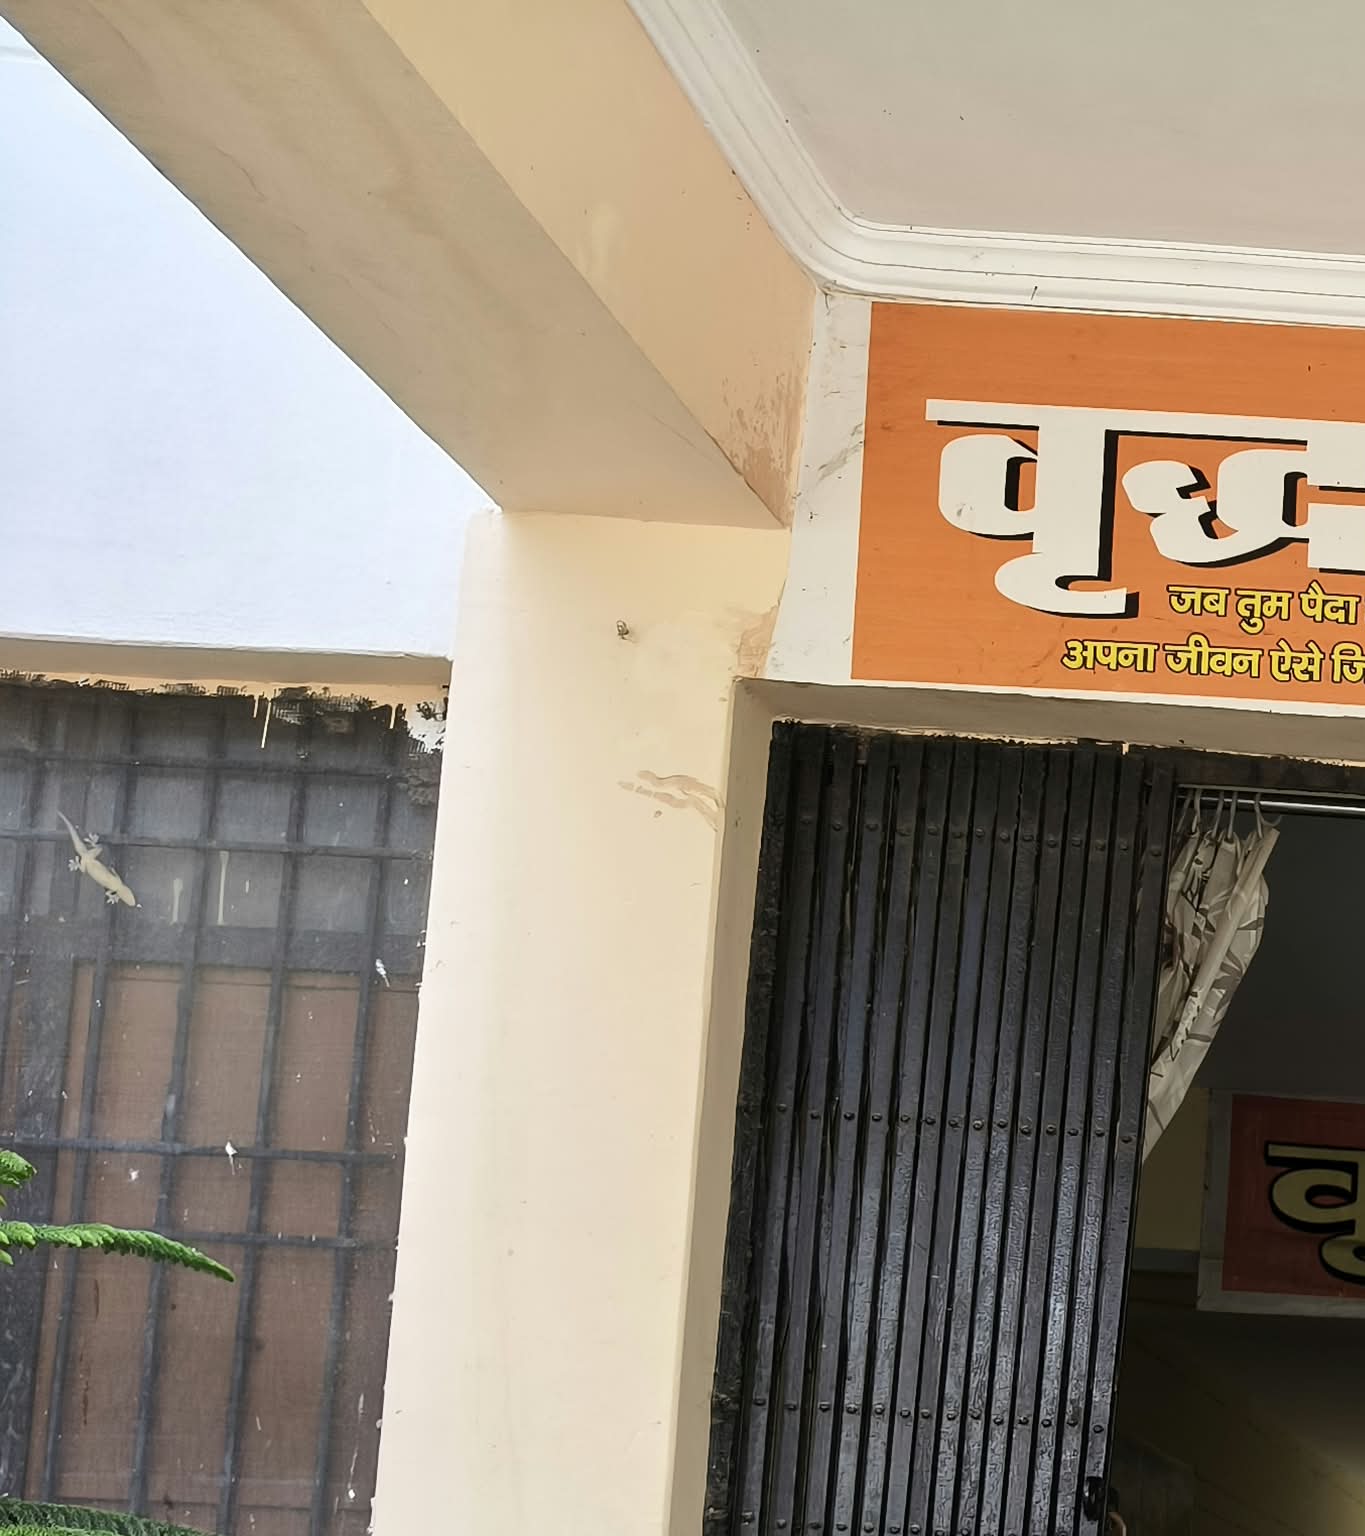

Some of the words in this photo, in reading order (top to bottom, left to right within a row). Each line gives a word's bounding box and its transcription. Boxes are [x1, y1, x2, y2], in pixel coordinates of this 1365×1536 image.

[1167, 584, 1230, 617] जब
[1236, 588, 1293, 634] तुम
[1299, 580, 1360, 625] पैदा
[1061, 638, 1159, 672] अपना
[1163, 633, 1264, 679] जीवन
[1270, 640, 1324, 682] ऐसे
